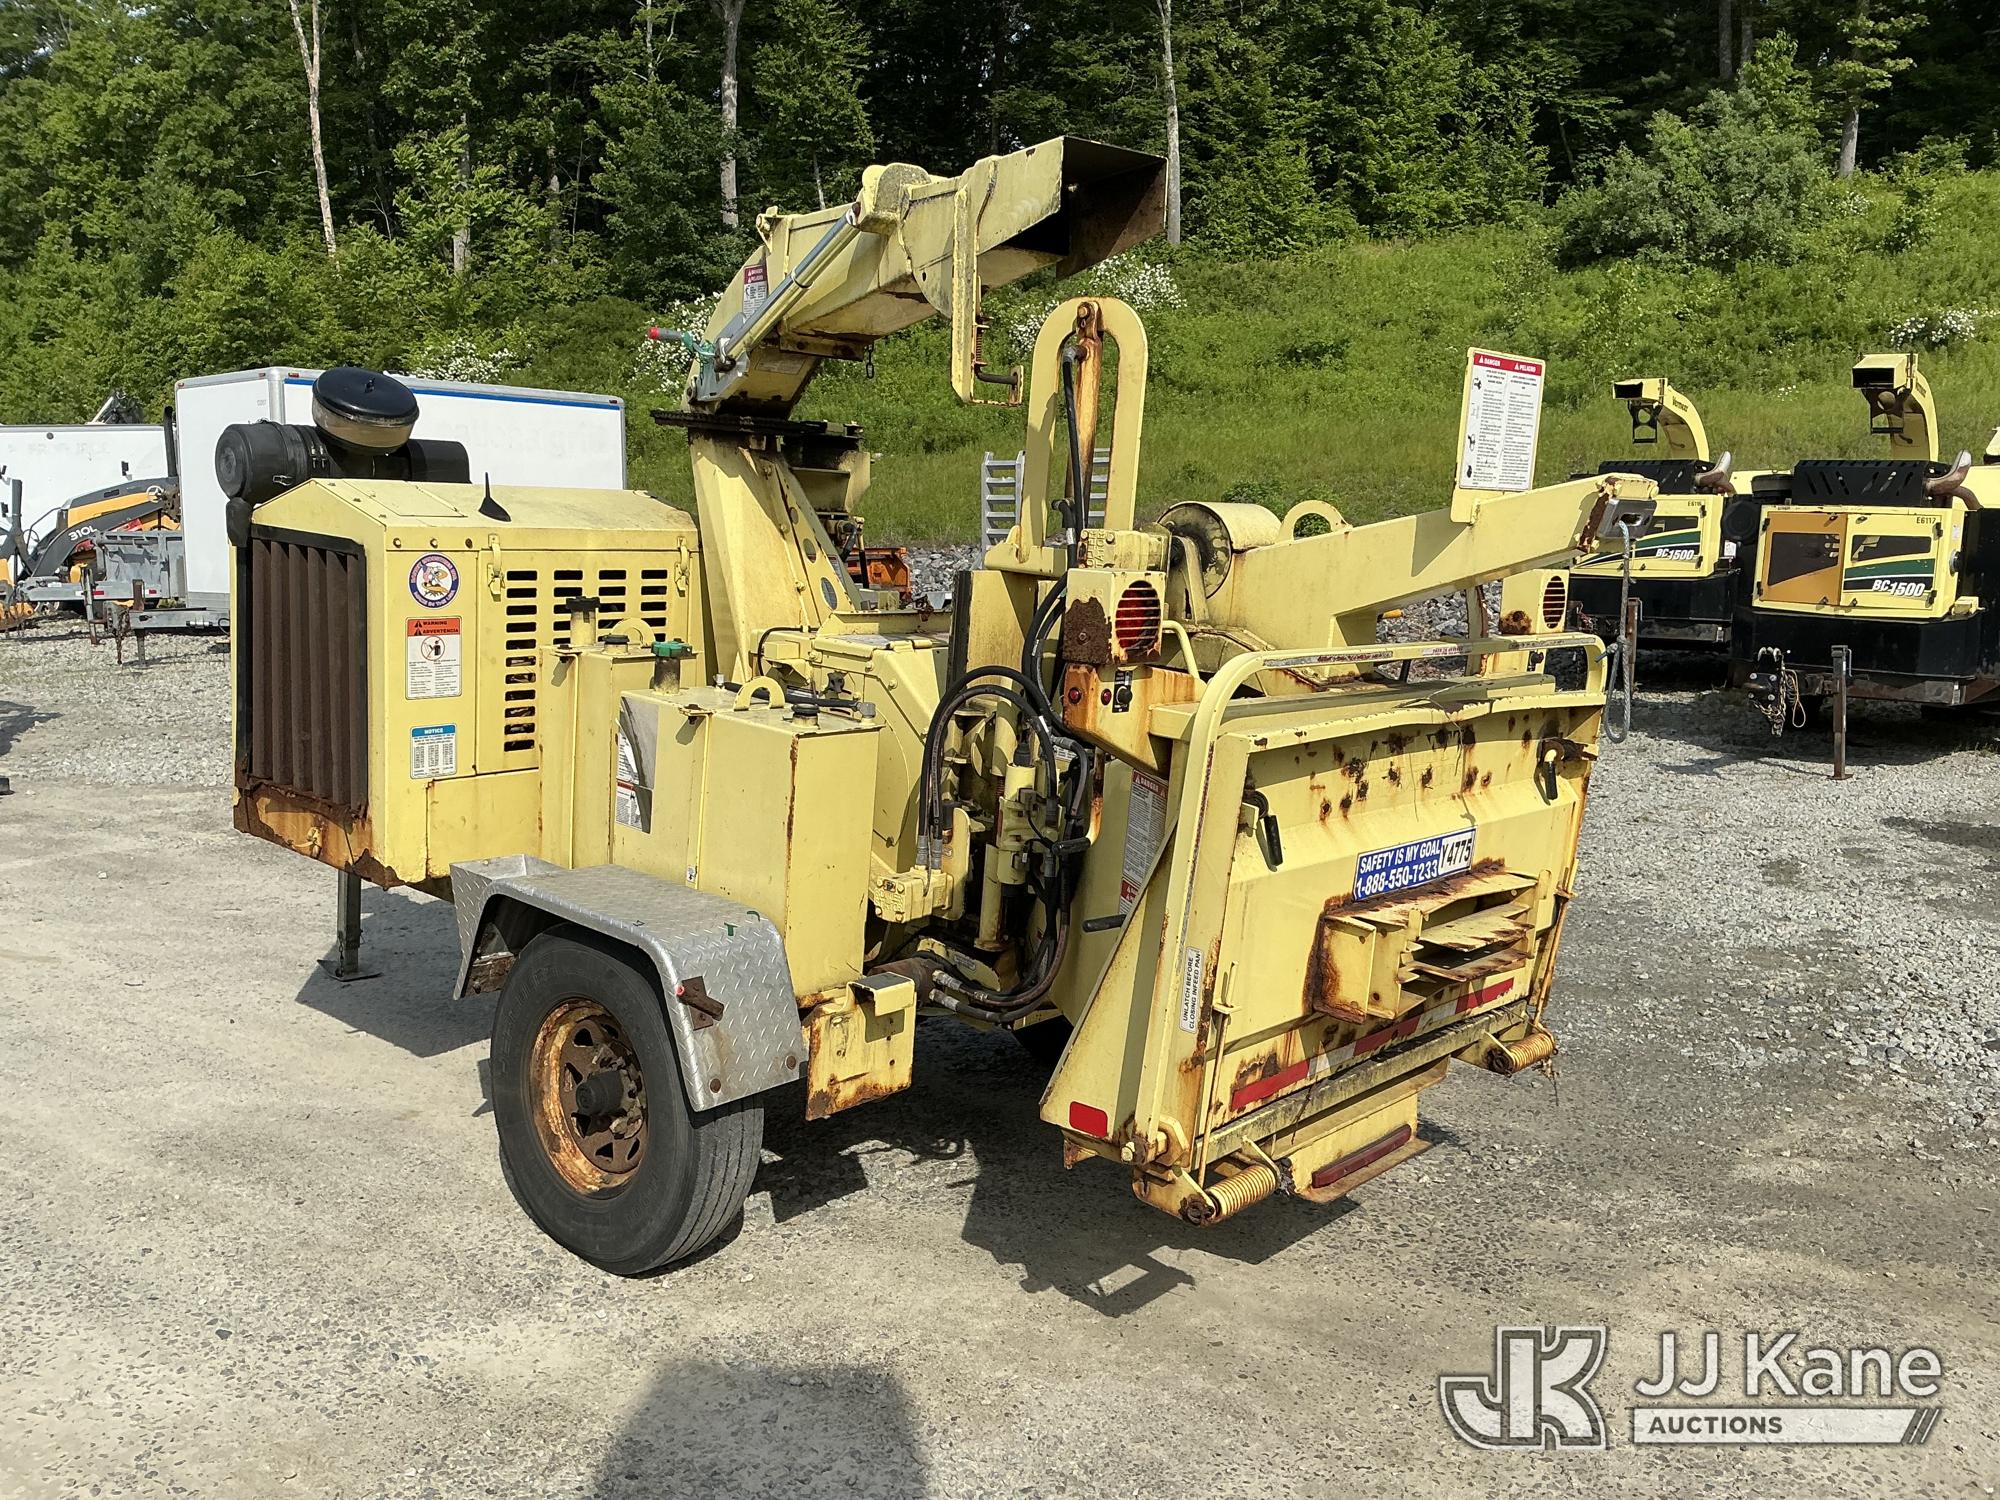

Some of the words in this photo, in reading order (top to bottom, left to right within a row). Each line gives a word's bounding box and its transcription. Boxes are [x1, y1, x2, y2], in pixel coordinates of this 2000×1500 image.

[1483, 358, 1501, 367] DANGER
[1519, 364, 1537, 373] PELIGRO
[68, 526, 97, 540] 310L
[1916, 516, 1937, 524] E6117
[1656, 548, 1695, 560] BC1500
[1872, 579, 1925, 597] BC1500
[1360, 851, 1395, 874] SAFETY
[1394, 848, 1405, 865] IS
[1405, 845, 1419, 863] MY
[1420, 839, 1441, 857] GOAL
[1441, 838, 1473, 869] Y4775
[1356, 859, 1438, 898] 1-888-550-7233
[1186, 957, 1194, 987] BEFORE
[1192, 970, 1200, 996] INFEED
[1183, 987, 1191, 1021] UNLATCH
[1189, 997, 1197, 1029] CLOSING
